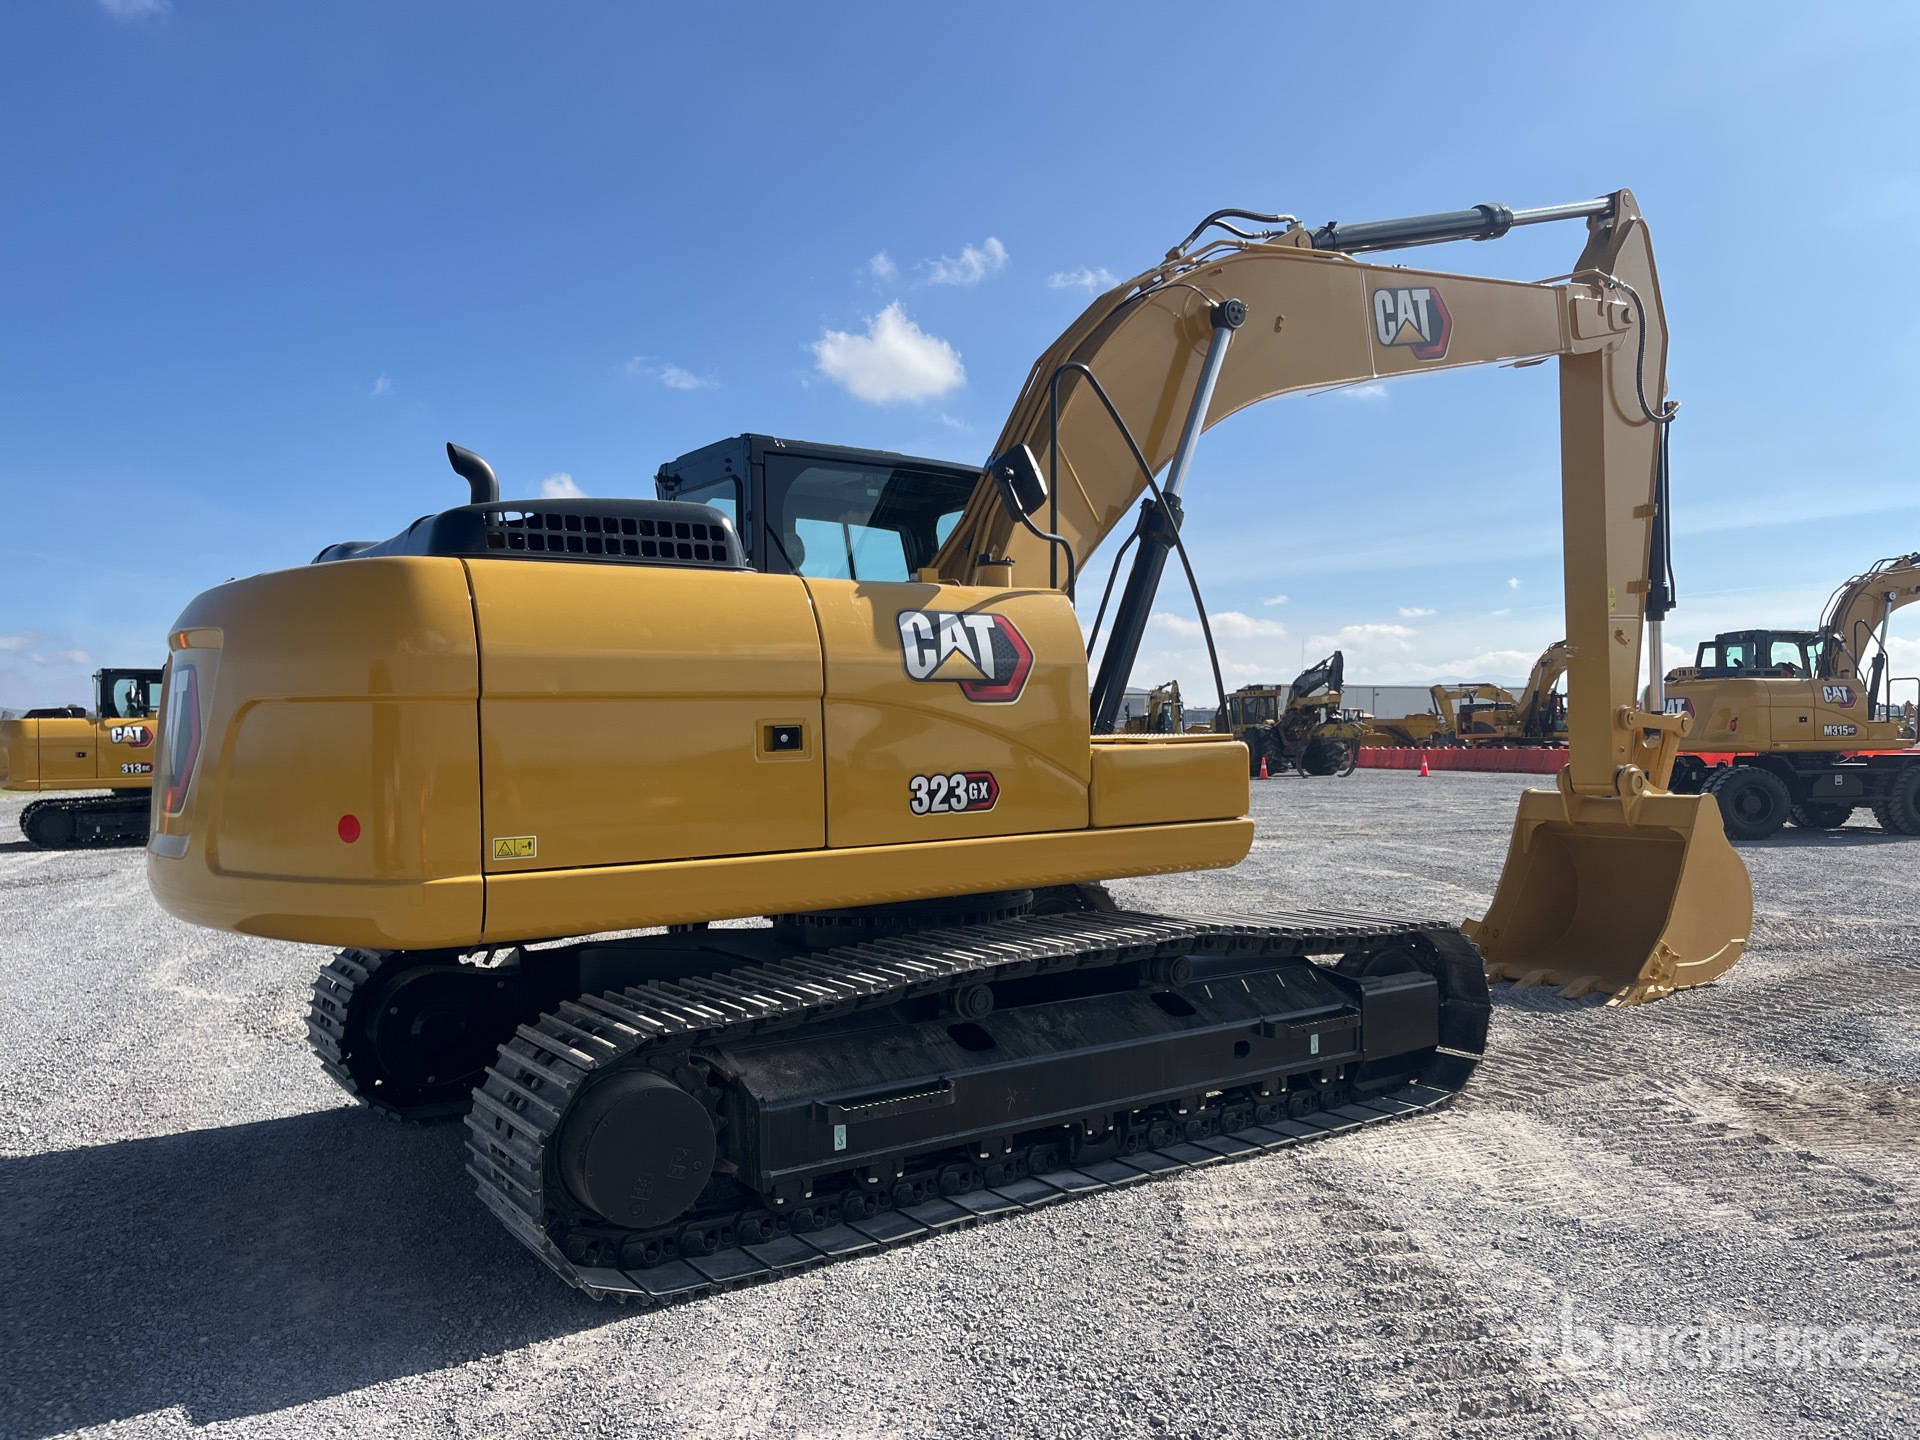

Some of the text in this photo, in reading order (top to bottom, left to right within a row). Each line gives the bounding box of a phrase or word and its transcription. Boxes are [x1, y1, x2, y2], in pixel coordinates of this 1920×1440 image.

[1374, 288, 1432, 345] CAT
[898, 611, 996, 680] CAT
[1822, 685, 1848, 704] CAT
[1663, 698, 1686, 715] AT
[111, 726, 143, 743] CAT
